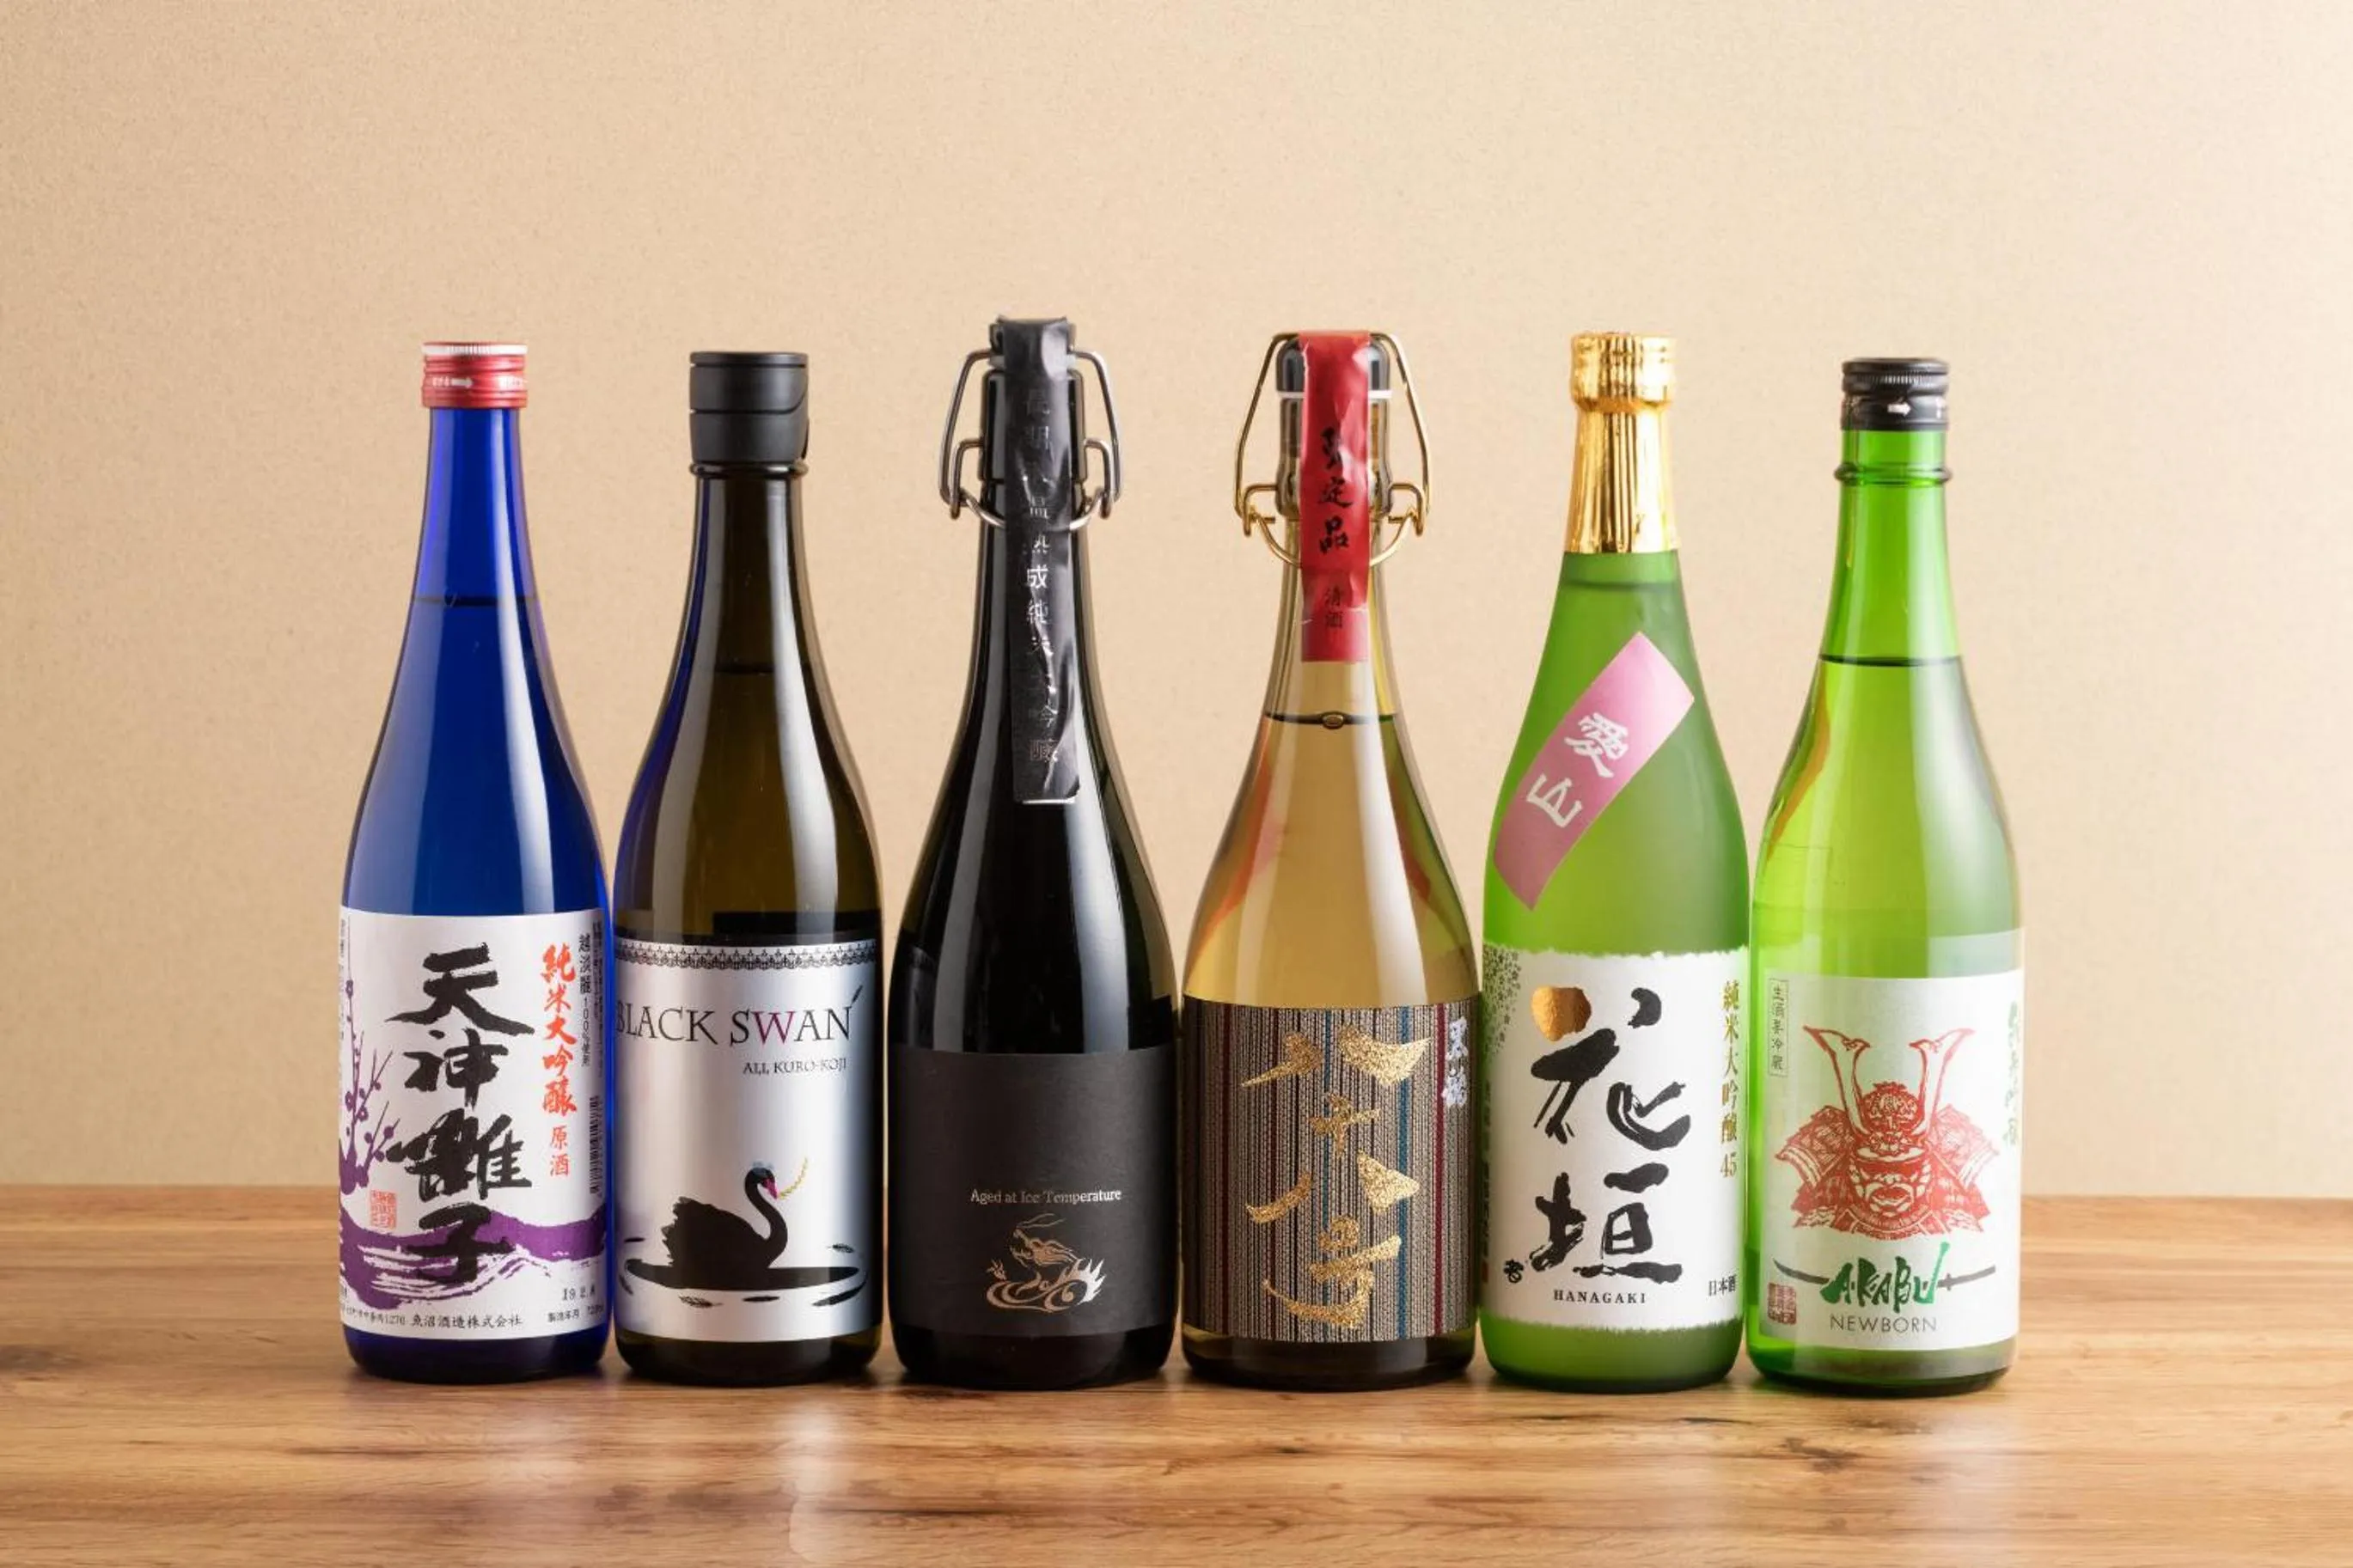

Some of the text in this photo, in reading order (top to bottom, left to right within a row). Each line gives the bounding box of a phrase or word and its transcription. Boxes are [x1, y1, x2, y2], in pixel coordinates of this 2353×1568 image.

[1526, 711, 1630, 829] 愛山
[540, 943, 578, 1118] 純米大吟醸
[615, 983, 865, 1049] BLACK SWAN
[743, 1055, 848, 1076] ALL KURO-KOJI
[1719, 979, 1740, 1180] 純米大吟醸 45
[548, 1124, 571, 1178] 原酒
[1529, 986, 1693, 1285] 花垣
[969, 1187, 1122, 1205] Aged at Ice Temperature
[1553, 1290, 1647, 1305] HANAGAKI
[1829, 1315, 1938, 1334] NEWBORN
